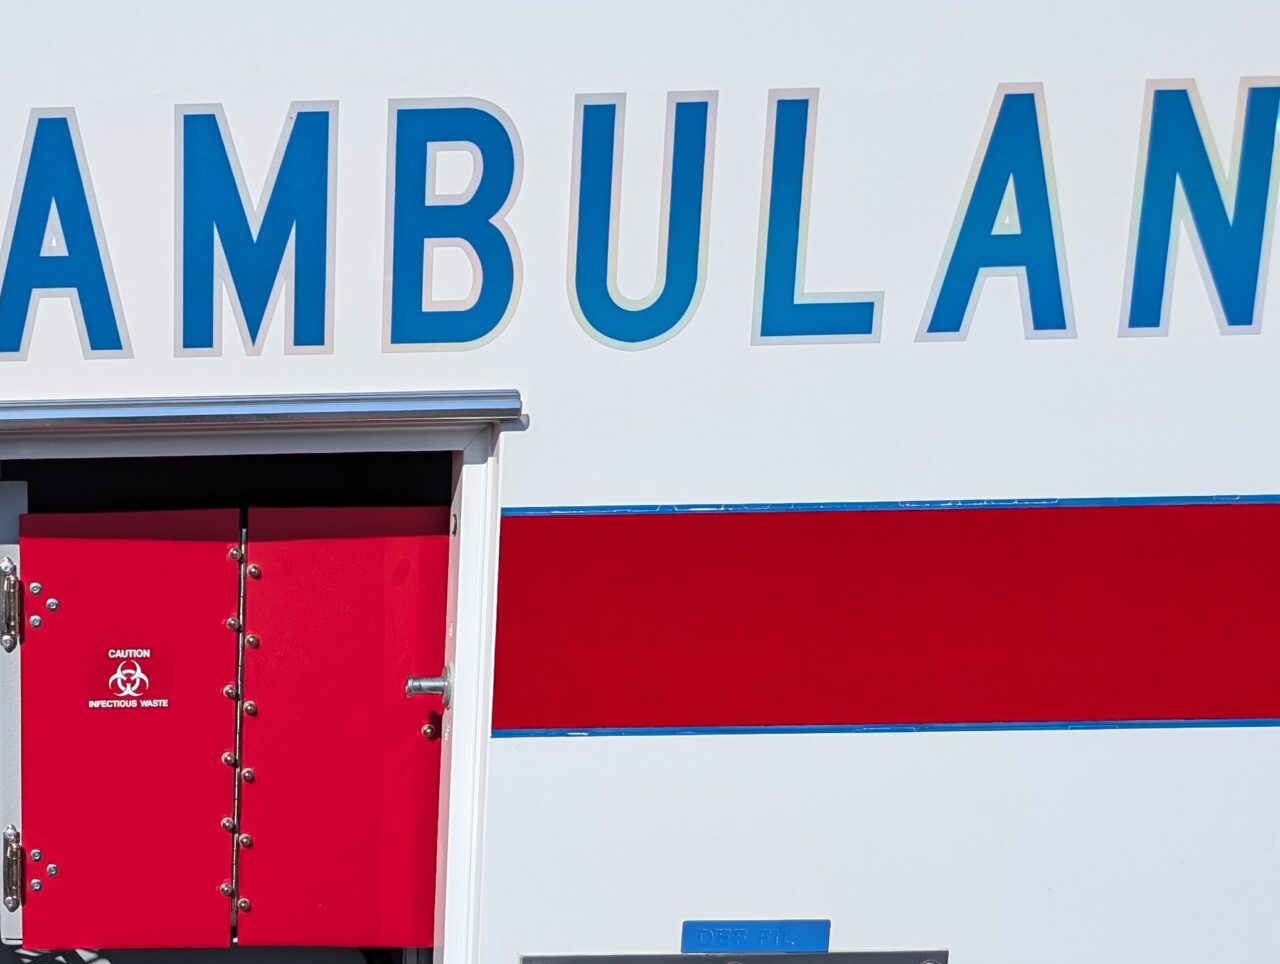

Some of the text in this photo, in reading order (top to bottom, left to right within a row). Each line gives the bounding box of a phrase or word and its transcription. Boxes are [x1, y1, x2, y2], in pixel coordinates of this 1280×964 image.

[108, 649, 150, 658] CAUTION
[88, 699, 169, 708] INFECTIOUS WASTE
[697, 928, 748, 945] DEF
